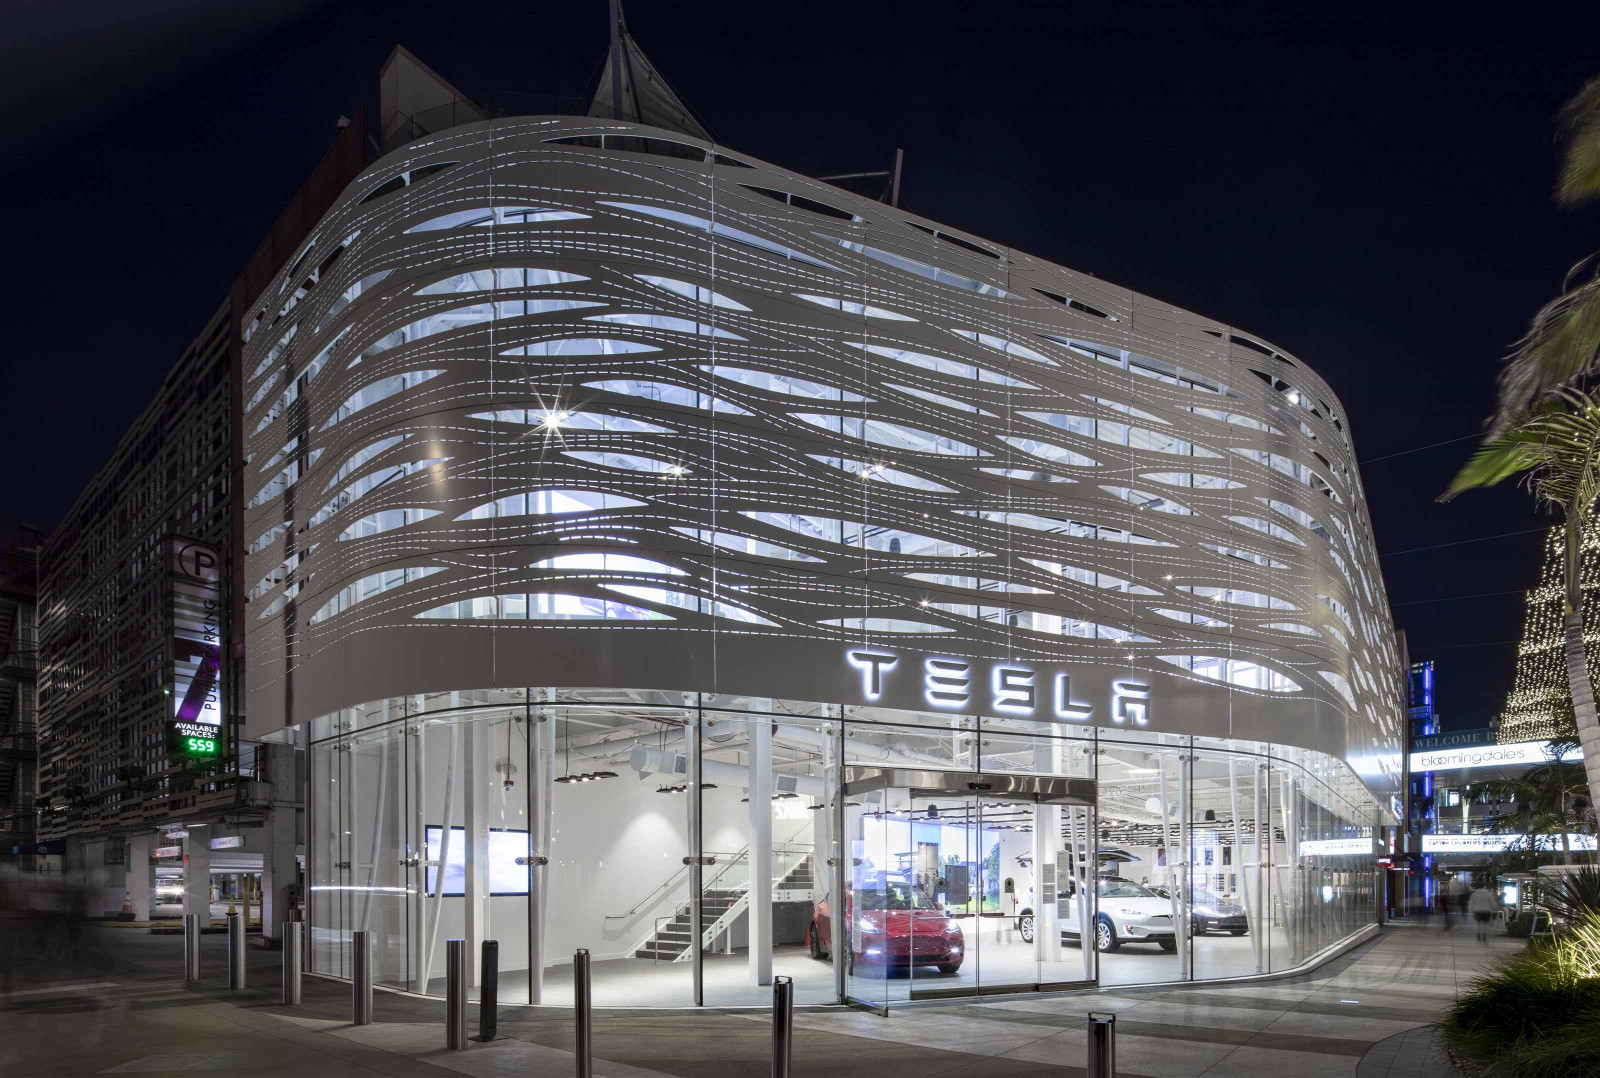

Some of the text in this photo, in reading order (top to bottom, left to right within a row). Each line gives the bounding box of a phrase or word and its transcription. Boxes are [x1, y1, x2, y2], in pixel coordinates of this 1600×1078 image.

[194, 550, 216, 576] P
[203, 600, 217, 711] PUBLIC PARKING
[847, 650, 1151, 725] TESLA
[175, 722, 218, 733] AVAILABLE
[181, 729, 215, 739] SPACES:
[1414, 732, 1480, 748] WELCOME
[1421, 749, 1525, 767] bloomingdale's
